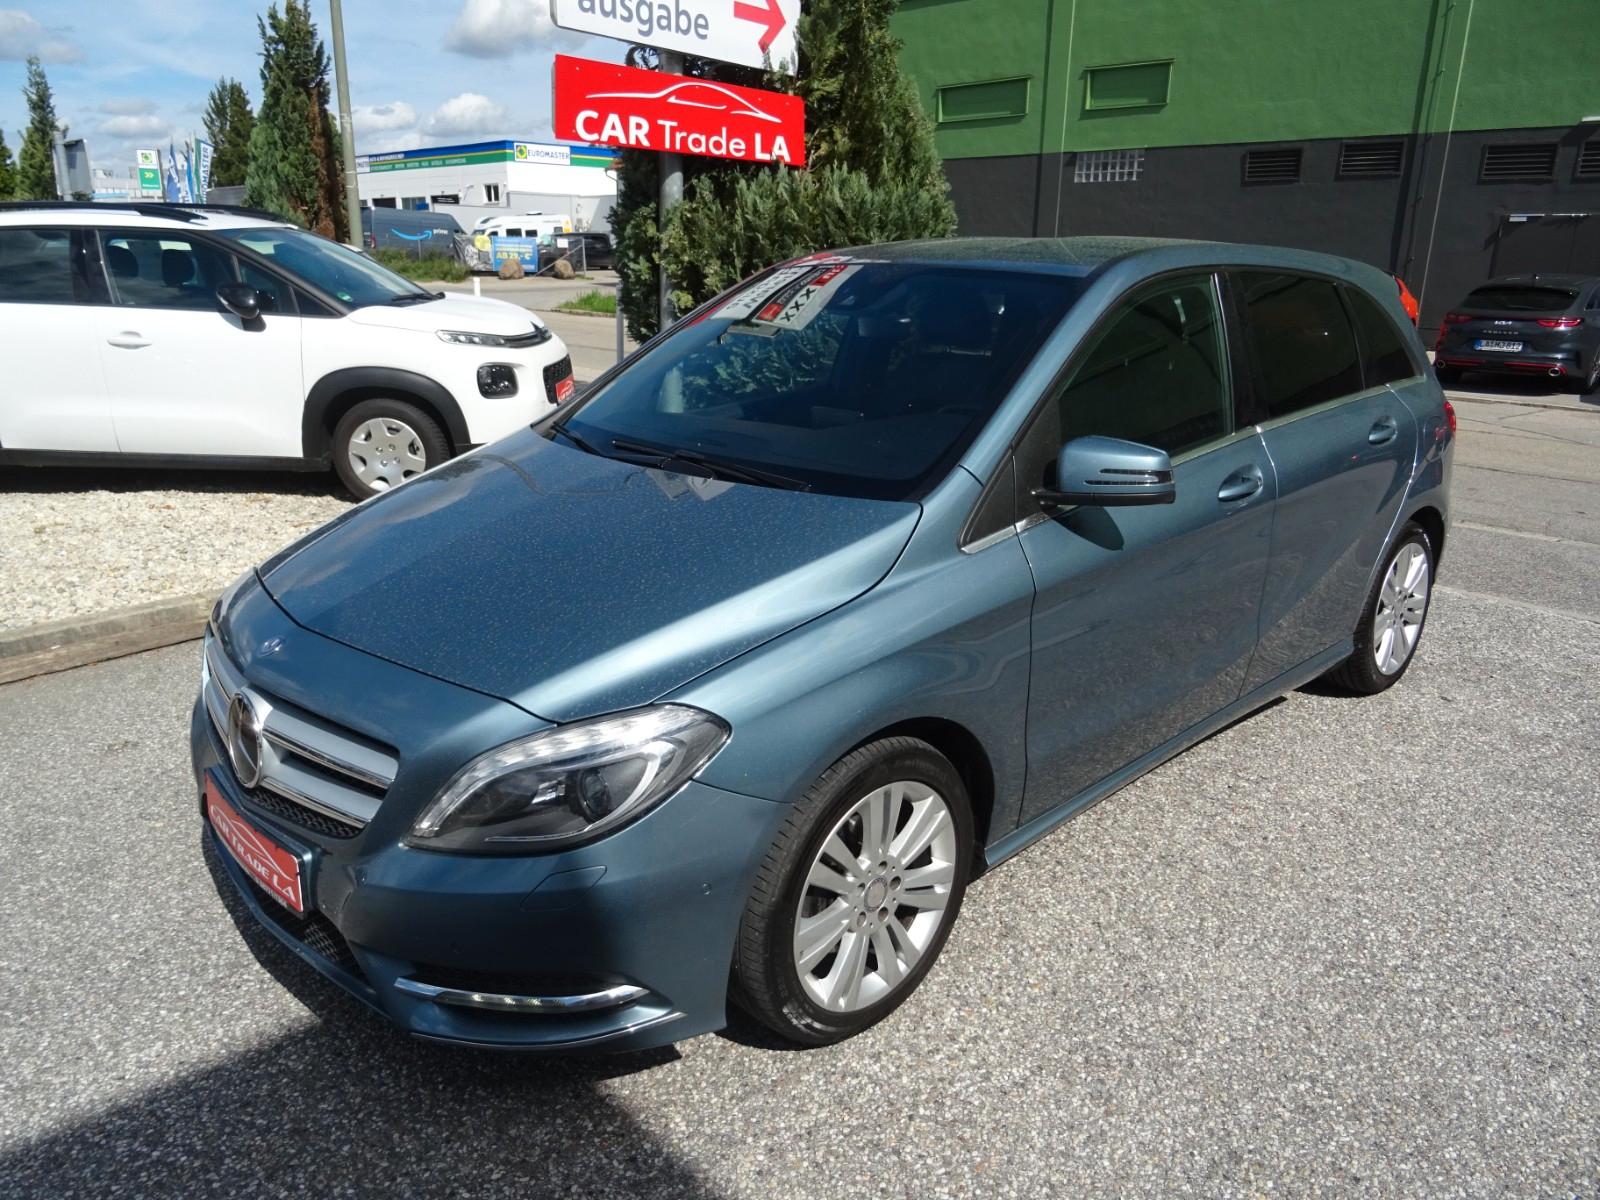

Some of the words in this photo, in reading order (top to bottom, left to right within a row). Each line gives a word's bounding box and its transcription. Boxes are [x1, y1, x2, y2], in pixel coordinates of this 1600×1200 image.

[528, 149, 569, 160] EUROMASTER
[575, 110, 650, 147] CAR
[657, 119, 746, 157] Trade
[754, 133, 791, 162] LA
[210, 805, 230, 838] CAR
[231, 836, 270, 879] TRADE
[272, 874, 297, 903] LA
